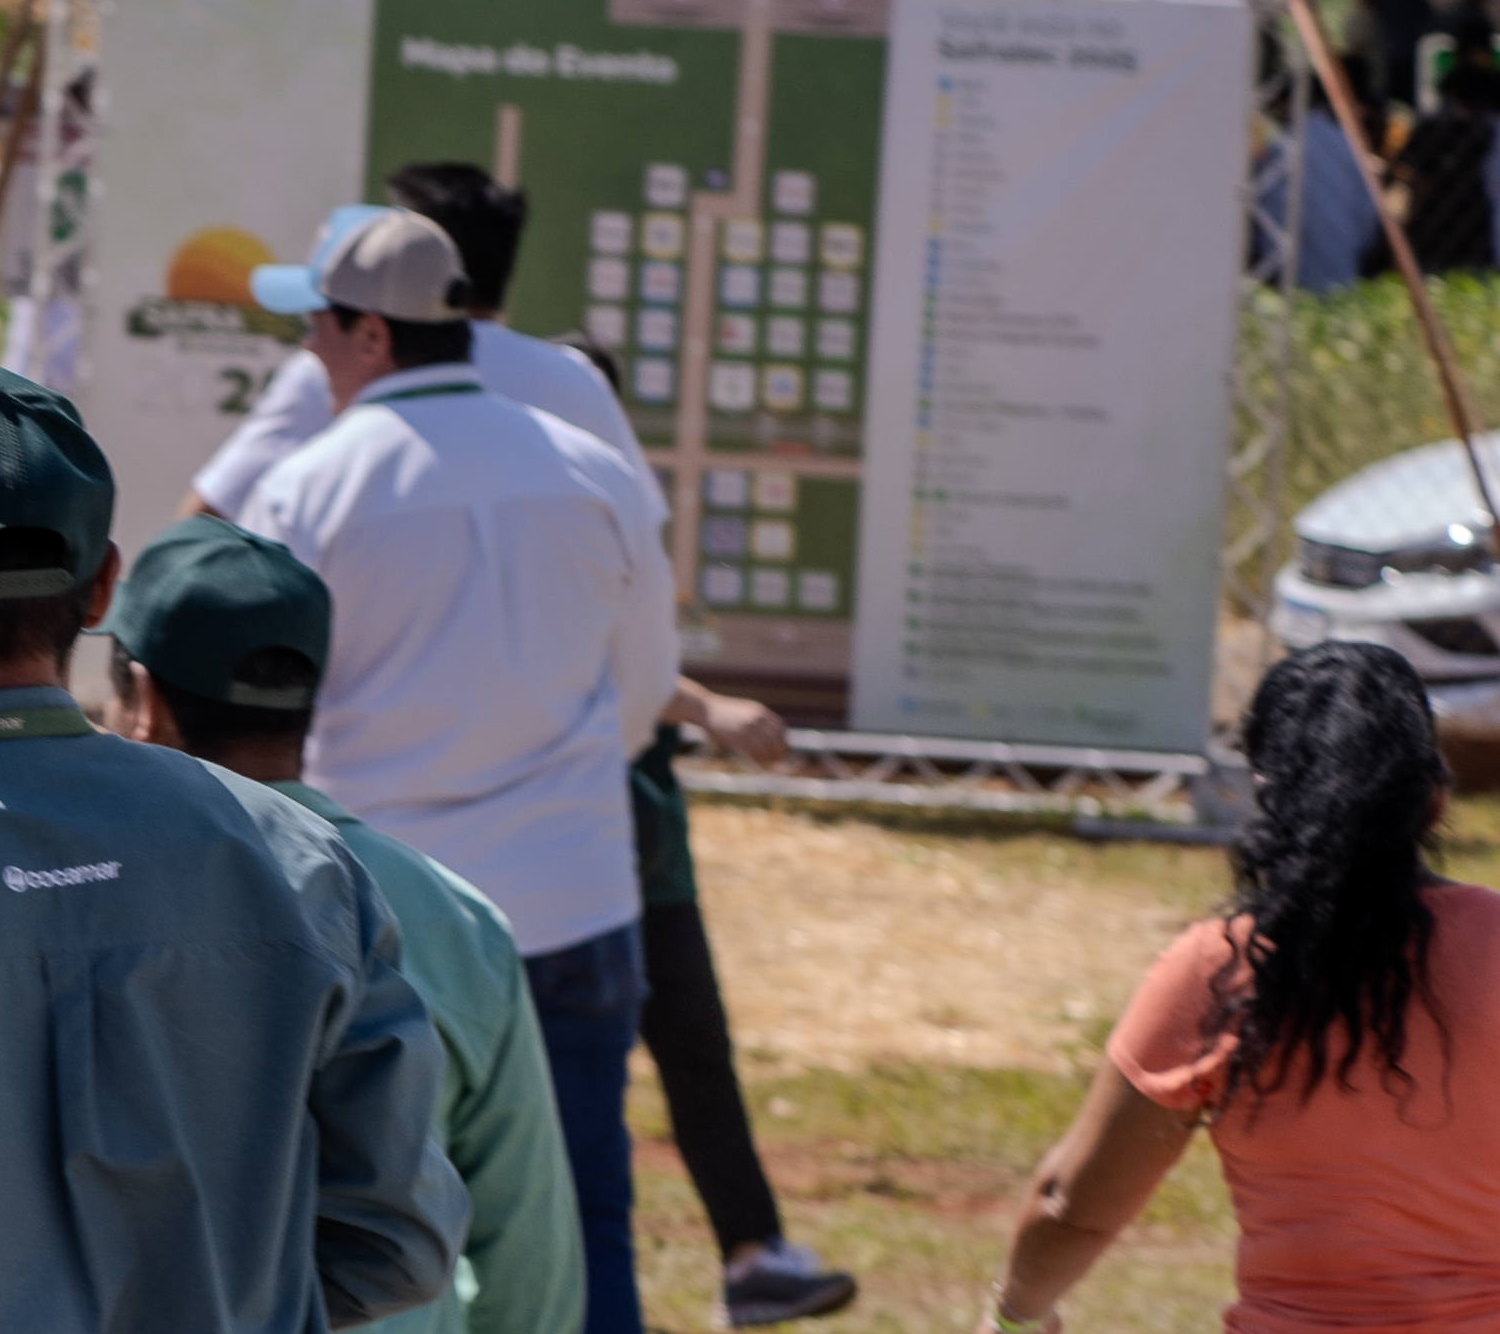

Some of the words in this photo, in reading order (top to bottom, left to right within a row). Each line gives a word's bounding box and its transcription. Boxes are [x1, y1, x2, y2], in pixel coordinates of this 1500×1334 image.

[402, 38, 496, 79] Mapa
[555, 44, 677, 84] Evento
[26, 860, 123, 889] cocamar
